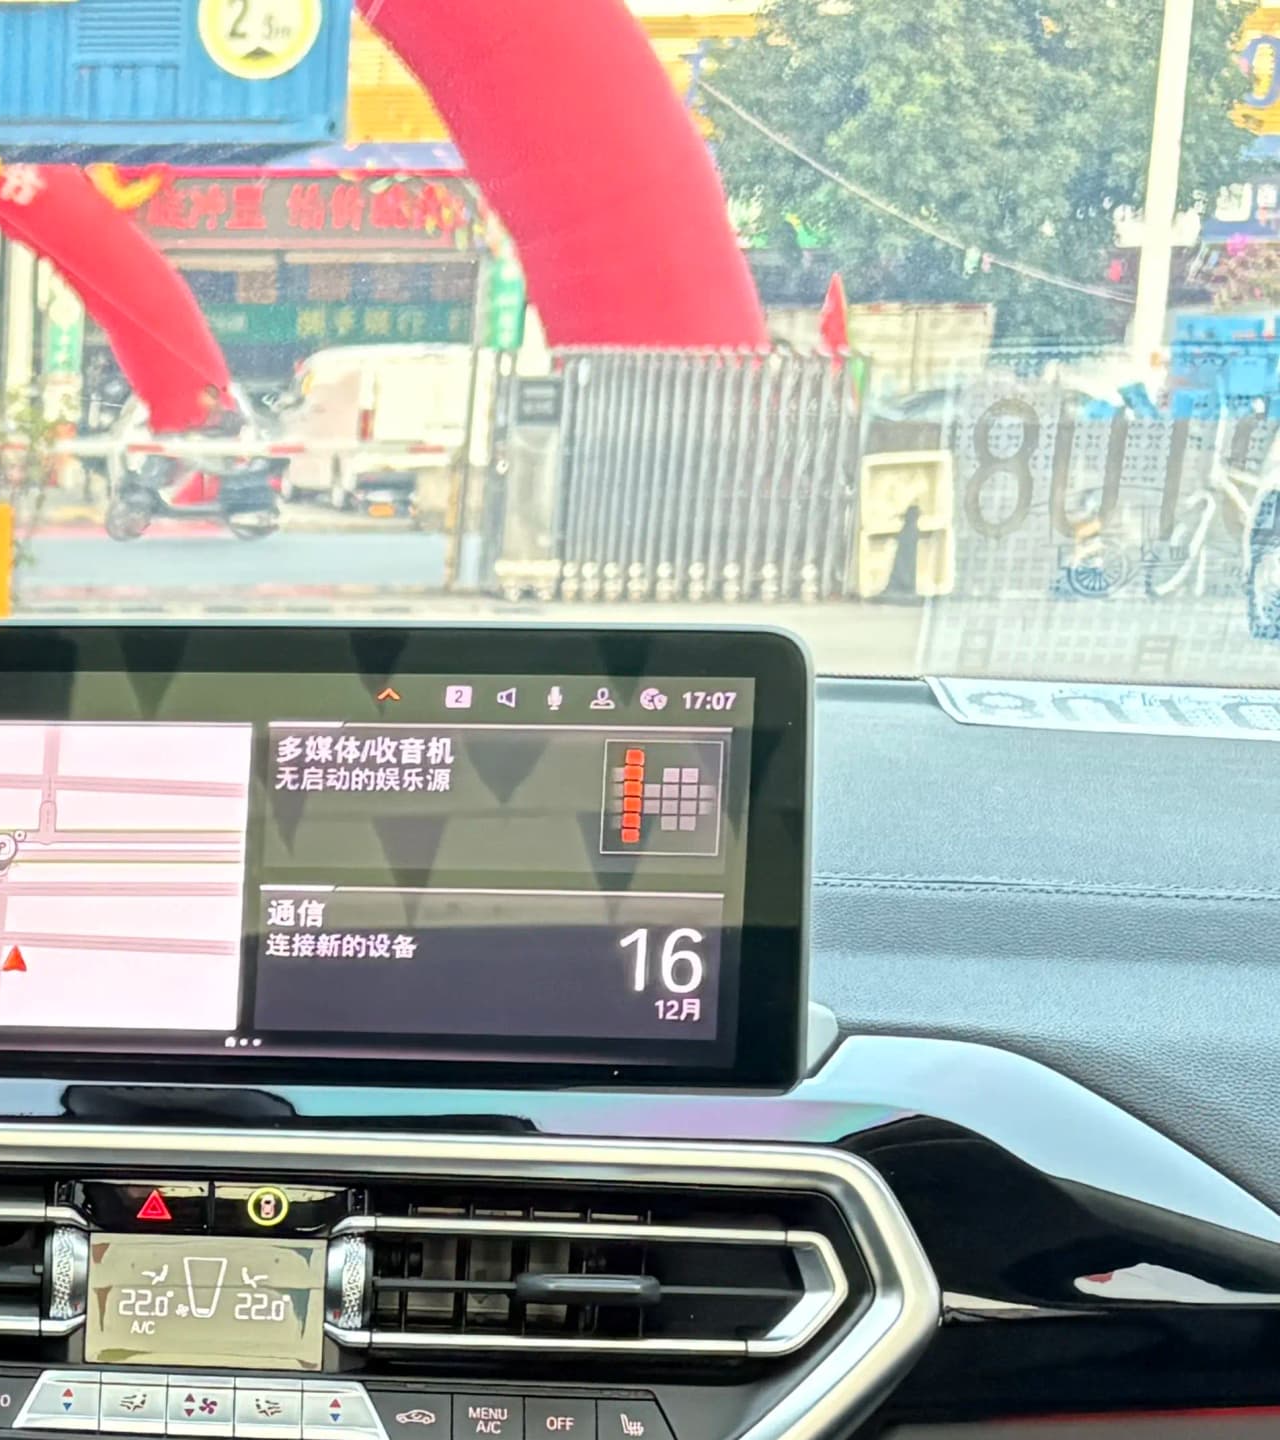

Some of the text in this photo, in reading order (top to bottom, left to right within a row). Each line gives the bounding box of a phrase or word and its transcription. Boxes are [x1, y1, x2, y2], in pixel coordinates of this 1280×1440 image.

[682, 692, 737, 711] 17:07
[276, 735, 454, 766] 多媒体/收音机
[275, 766, 451, 793] 无启动的娱乐源
[266, 899, 325, 928] 通信
[265, 934, 417, 959] 连接新的设备
[619, 927, 703, 994] 16
[654, 998, 701, 1021] 12月
[130, 1320, 156, 1335] A/C
[468, 1406, 508, 1420] MENU
[546, 1416, 575, 1431] OFF
[476, 1420, 501, 1434] A/C
